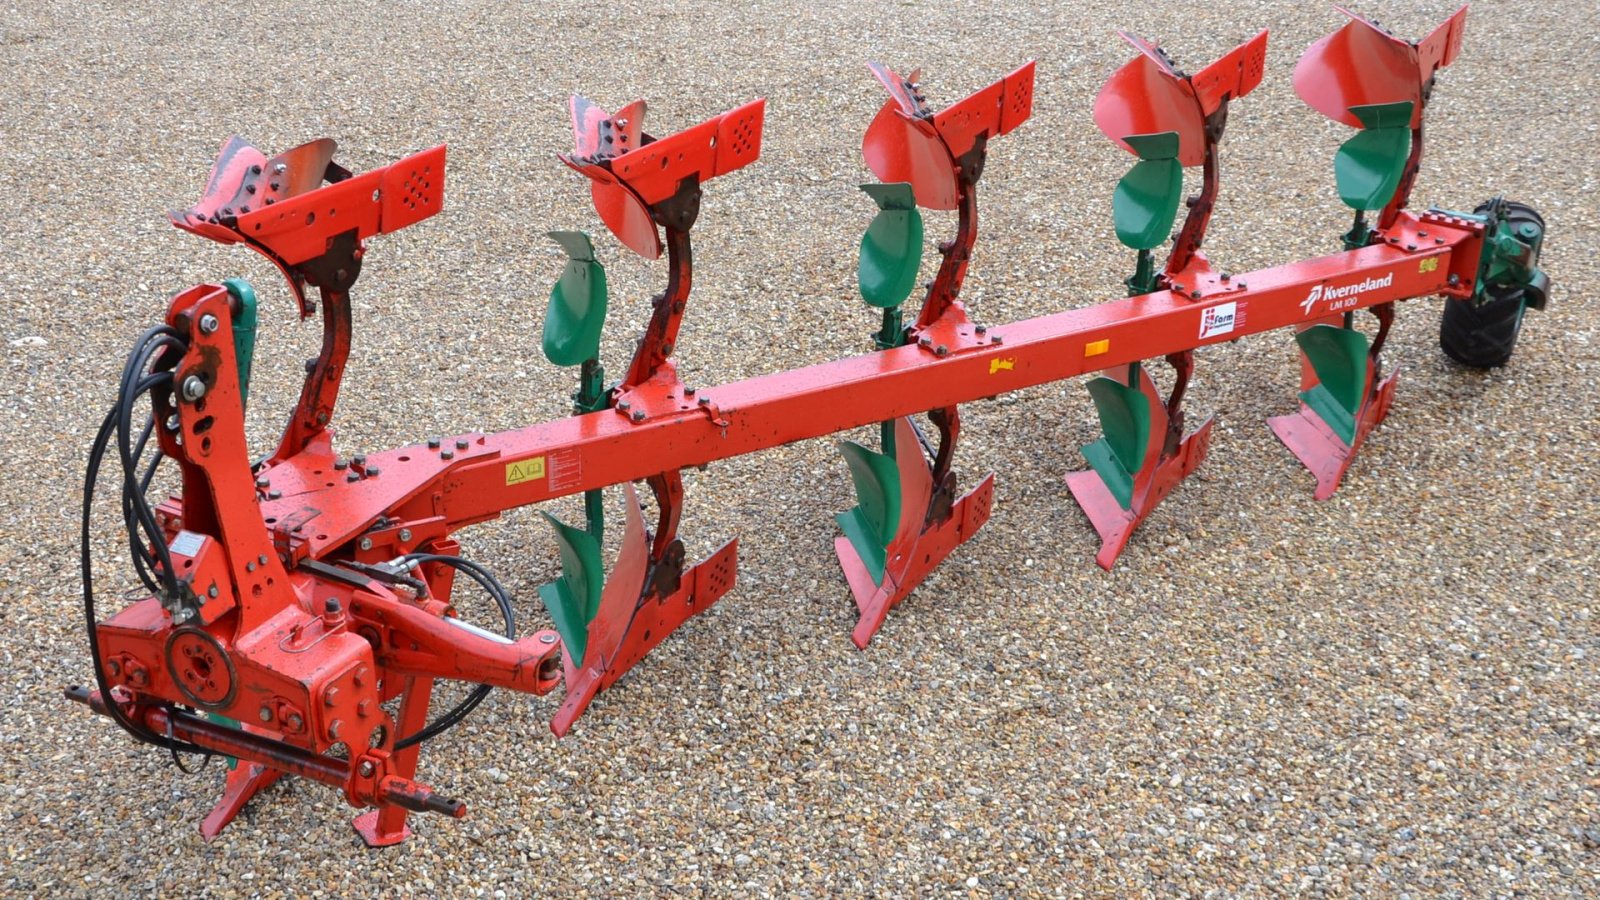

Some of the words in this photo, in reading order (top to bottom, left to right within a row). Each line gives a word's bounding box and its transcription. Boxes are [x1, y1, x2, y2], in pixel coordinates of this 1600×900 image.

[1323, 272, 1393, 301] Kverneland
[1330, 301, 1343, 311] LM
[1344, 297, 1358, 307] 100
